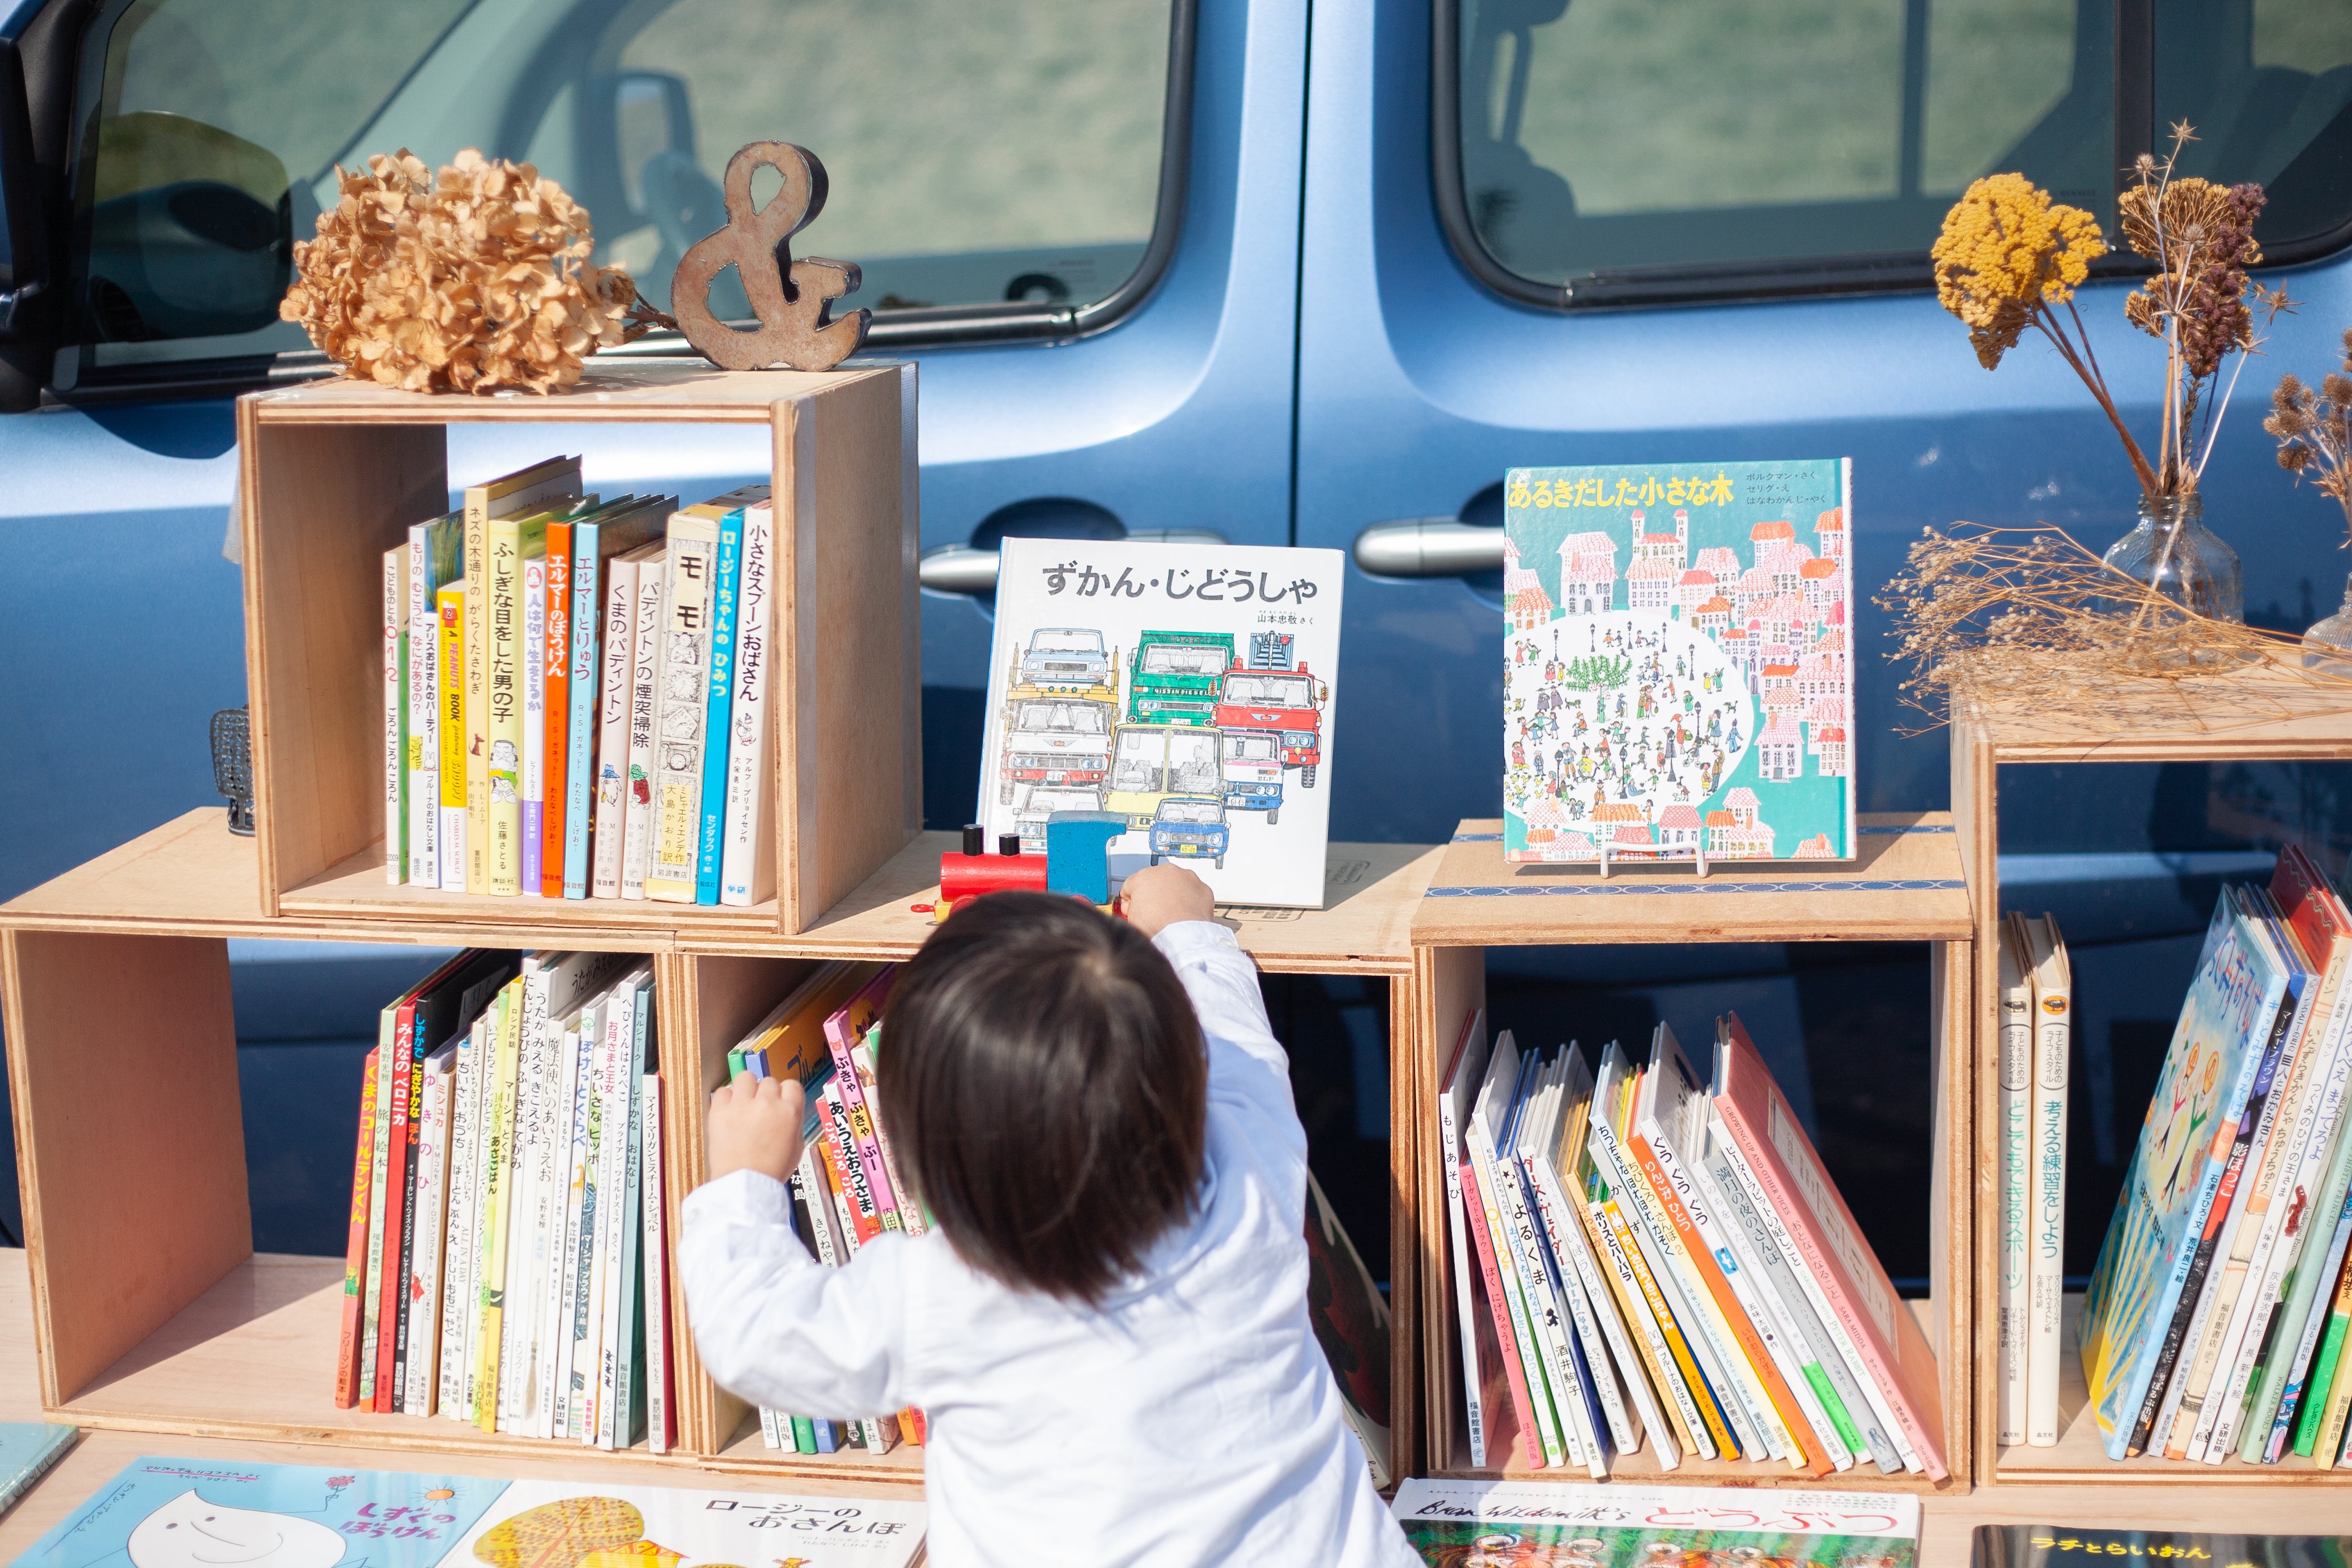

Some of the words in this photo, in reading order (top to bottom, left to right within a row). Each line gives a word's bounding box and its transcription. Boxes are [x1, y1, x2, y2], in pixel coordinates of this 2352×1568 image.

[1508, 473, 1734, 509] あるきだした小さな木
[1746, 471, 1816, 481] ボルクマン・さく
[1746, 484, 1790, 493] セリグ・え
[1746, 495, 1825, 505] はなわかんじ・やく
[412, 542, 423, 576] もりの
[469, 507, 481, 596] ネズの木通りの
[411, 583, 423, 627] むこうに
[716, 532, 736, 644] ロージーちゃんの
[1042, 560, 1318, 604] ずかん・じどうしゃ
[493, 543, 514, 723] ふしぎな目をした男の子
[547, 555, 568, 677] エルマーのぼうけん
[575, 558, 594, 681] エルマーとりゅう
[739, 525, 767, 702] 小さなスプーンおばさん
[1258, 614, 1298, 624] 山本忠敬
[448, 643, 459, 689] PEANUTS
[469, 604, 482, 694] がらくたさわぎ
[527, 594, 541, 711] 人は何で生きるか
[606, 585, 627, 724] くまのパディントン
[632, 582, 660, 748] パディントンの煙突掃除
[425, 623, 436, 743] アリスおばさんのパーティー
[712, 653, 728, 696] ひみつ
[387, 707, 397, 736] ころん
[451, 694, 460, 722] BOOK
[388, 741, 397, 770] ころん
[452, 759, 462, 800] SNOOPY
[388, 774, 397, 802] ころん
[498, 821, 507, 869] 佐藤さとる
[663, 785, 676, 862] 大島かおり訳
[675, 787, 687, 862] ミヒャエル・エンデ作
[704, 814, 716, 852] センダック
[657, 869, 687, 878] 岩波書店
[2323, 955, 2345, 995] バートン
[414, 1013, 426, 1059] しずかで
[508, 1009, 517, 1048] ロシア民話
[519, 974, 534, 1065] たんじょうびの
[534, 993, 547, 1031] うたが
[634, 1012, 646, 1060] マルシャーク
[394, 1023, 413, 1073] みんなの
[532, 1038, 545, 1076] みえる
[604, 1021, 618, 1095] お月さまと王女
[618, 998, 632, 1103] へびくんはらぺこ
[2054, 1031, 2063, 1083] 子どものための
[2260, 1010, 2292, 1083] マーシャ・ブラウン
[410, 1063, 422, 1119] にぎやかな
[514, 1071, 528, 1124] ふしぎな
[590, 1069, 604, 1123] ちいさな
[2282, 1029, 2320, 1125] いたずらきかんしゃ
[392, 1079, 408, 1126] ベロニカ
[435, 1084, 445, 1128] ミシュカ
[454, 1063, 469, 1149] ちいさいおうち
[499, 1081, 514, 1163] マーシャとくま
[527, 1082, 542, 1145] きこえるよ
[538, 1038, 561, 1182] 魔法使いのあいうえお
[629, 1084, 641, 1131] しずかな
[836, 1056, 856, 1093] ぶきゃ
[850, 1102, 869, 1137] ぶきゃ
[864, 1145, 877, 1171] ぶー
[2308, 1088, 2342, 1161] まってろよ
[2340, 1096, 2348, 1110] Six
[351, 1065, 377, 1224] くまのコールテンくん
[407, 1123, 419, 1145] ほん
[511, 1131, 527, 1170] てがみ
[587, 1128, 602, 1165] ヒッポ
[829, 1101, 873, 1213] あいうえおうさま
[1444, 1115, 1462, 1199] もじあそび
[2278, 1083, 2322, 1197] つぐみのひげの王さま
[488, 1135, 500, 1195] あさごはん
[626, 1144, 638, 1189] おはなし
[825, 1123, 838, 1144] ころ
[833, 1149, 846, 1171] ころ
[841, 1177, 855, 1199] ころ
[826, 1155, 837, 1177] エッツ
[1654, 1137, 1673, 1163] ぐう
[1672, 1168, 1691, 1195] ぐう
[1689, 1199, 1708, 1226] ぐう
[1726, 1107, 1747, 1142] GROWING
[1746, 1141, 1755, 1153] UP
[1752, 1154, 1764, 1169] AND
[1761, 1170, 1778, 1195] OTHER
[1776, 1195, 1791, 1216] VICES
[2041, 1100, 2062, 1259] 考える練習をしよう
[2260, 1128, 2286, 1192] ちゅうちゅう
[803, 1163, 818, 1207] わかやまけん
[1627, 1162, 1678, 1242] ちびくろ・さんぼ
[1675, 1244, 1686, 1256] 2
[1644, 1161, 1672, 1201] りんごが
[1669, 1202, 1691, 1232] ひとつ
[1726, 1143, 1801, 1267] ピーターラビットの庭しごと
[2006, 1099, 2026, 1290] どこでもできるスポーツ
[2193, 1174, 2220, 1230] 石津ちひろ・文
[2326, 1189, 2342, 1229] PRINCESS
[1701, 1174, 1757, 1266] いのちをいただく
[1716, 1166, 1781, 1267] 満月の夜のさんぽ
[567, 1221, 578, 1265] 今江祥智・文
[1514, 1204, 1546, 1285] よるくま
[1594, 1209, 1632, 1282] ボリスとバーバラ
[1791, 1220, 1841, 1300] おとなになること
[2175, 1236, 2198, 1284] 荒井良二・絵
[564, 1273, 574, 1309] 和田誠・絵
[1566, 1233, 1602, 1302] いばらひめ
[1620, 1234, 1674, 1332] ちいさなうさこちゃん
[1485, 1267, 1496, 1286] ぼく
[1491, 1293, 1512, 1353] にげちゃうよ
[1508, 1290, 1529, 1338] かえるさん
[1839, 1306, 1852, 1324] SARA
[1850, 1324, 1866, 1350] MIDDA
[2208, 1303, 2230, 1348] 福音館書店
[338, 1332, 351, 1393] フリーマンの絵本
[2299, 1323, 2320, 1361] ほるぷ出版
[408, 1343, 418, 1393] キーツの絵本
[441, 1347, 452, 1397] 岩波書店
[1555, 1344, 1580, 1396] 酒井駒子
[2270, 1376, 2285, 1406] WALKER
[555, 1396, 566, 1425] 文研出版
[1470, 1401, 1481, 1443] 福音館書店
[2262, 1406, 2273, 1430] BOOKS
[2307, 1403, 2320, 1439] クレヨンハウス
[2328, 1395, 2351, 1442] 福音館書店
[1815, 1419, 1841, 1456] 文化出版局
[2213, 1422, 2230, 1453] 文研出版
[338, 1519, 444, 1541] ぼうけん
[356, 1501, 457, 1524] しずくの
[706, 1499, 862, 1518] ロージーの
[748, 1515, 907, 1535] おさんぽ
[1415, 1500, 1481, 1518] Brian
[1645, 1506, 1899, 1532] どうぶつ
[2031, 1537, 2213, 1560] ラチとらいおん
